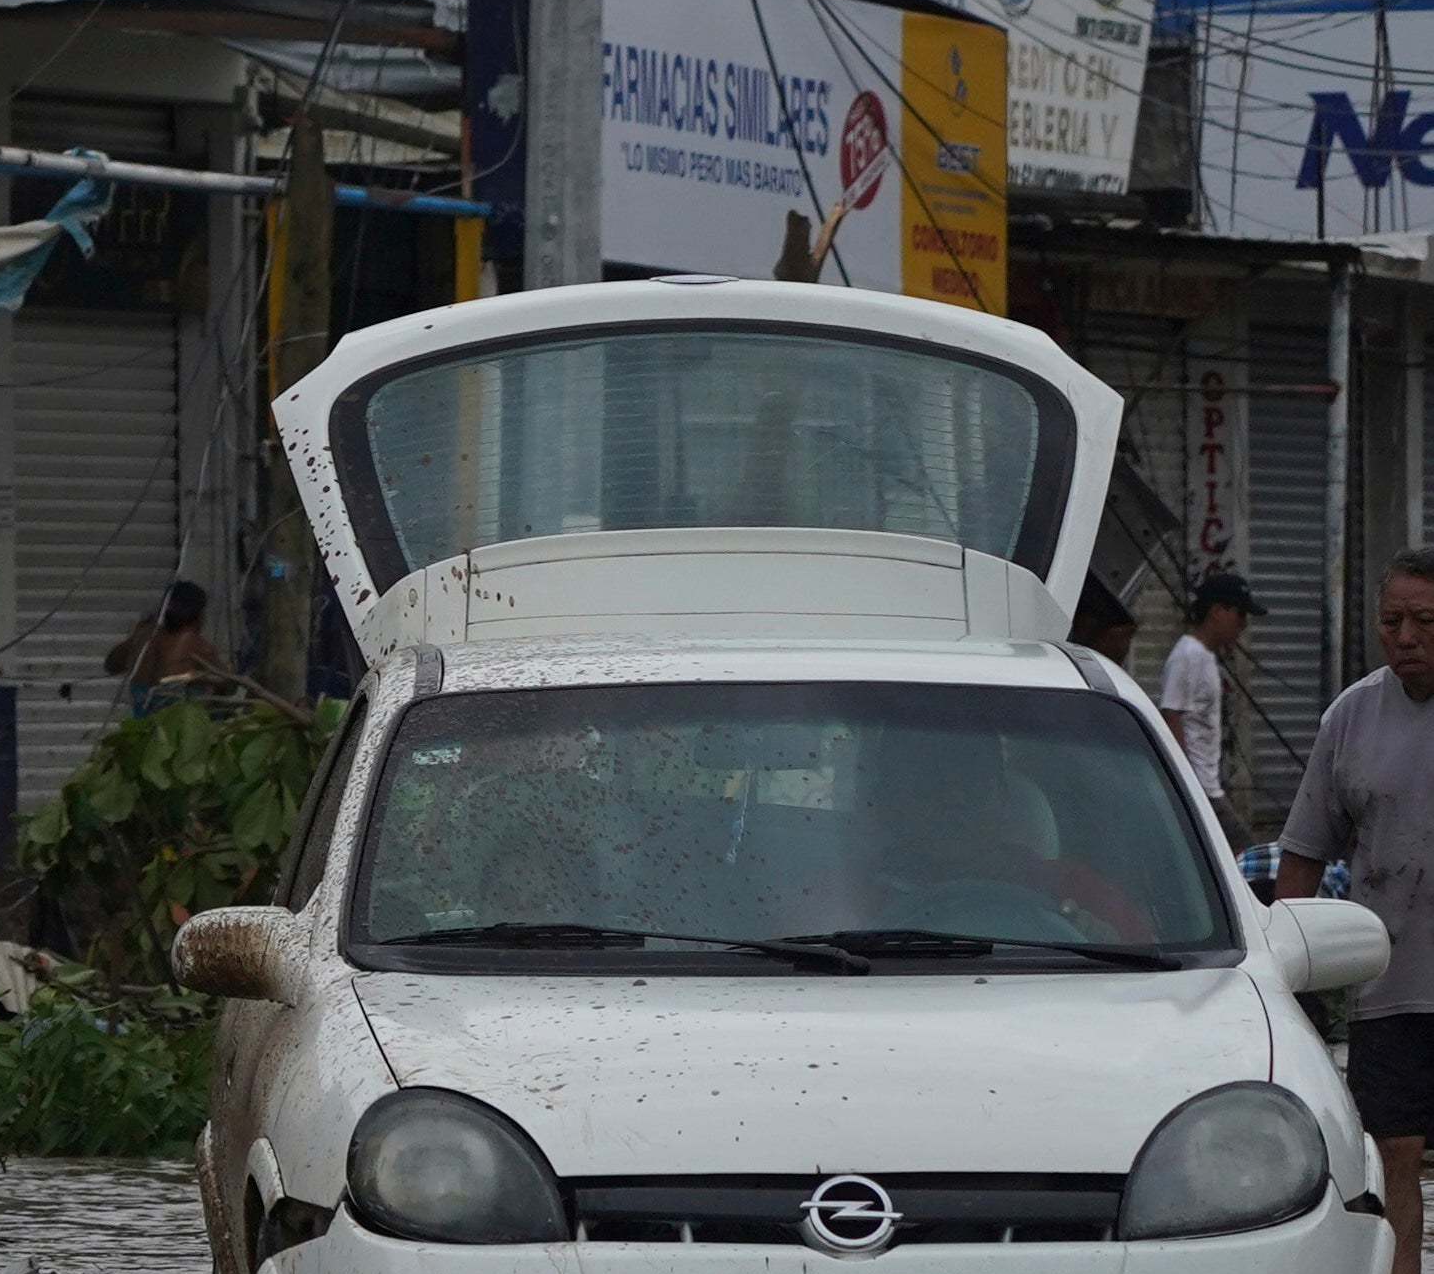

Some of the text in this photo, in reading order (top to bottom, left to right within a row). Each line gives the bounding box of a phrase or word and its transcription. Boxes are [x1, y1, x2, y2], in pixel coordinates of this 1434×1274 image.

[602, 42, 830, 158] FARMACIAS SIMILARES
[646, 145, 686, 178] MISMO
[690, 151, 722, 184] PERO
